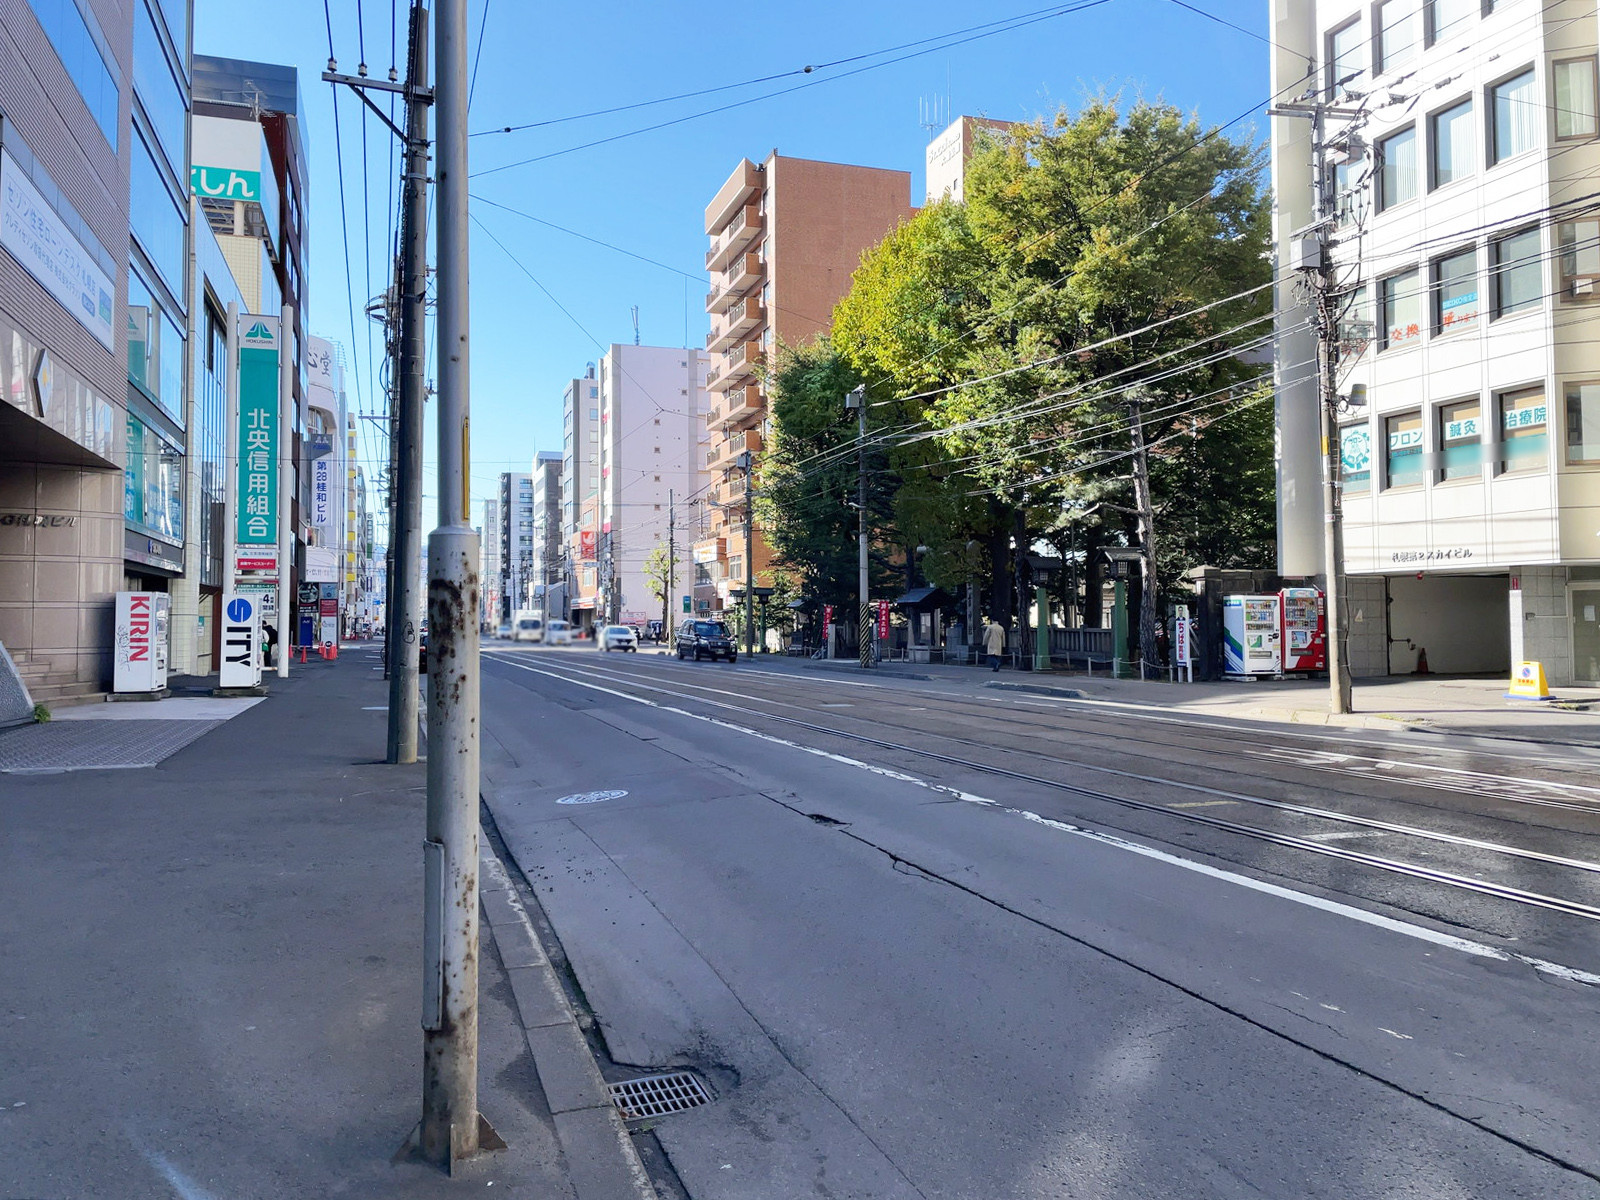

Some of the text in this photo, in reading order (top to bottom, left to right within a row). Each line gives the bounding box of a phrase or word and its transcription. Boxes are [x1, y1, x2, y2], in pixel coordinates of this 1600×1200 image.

[1391, 323, 1420, 341] 交換
[1449, 420, 1476, 438] 鍼灸
[1503, 406, 1547, 430] 治療院
[246, 408, 270, 537] 北央信用組合
[129, 595, 150, 662] KIRIN
